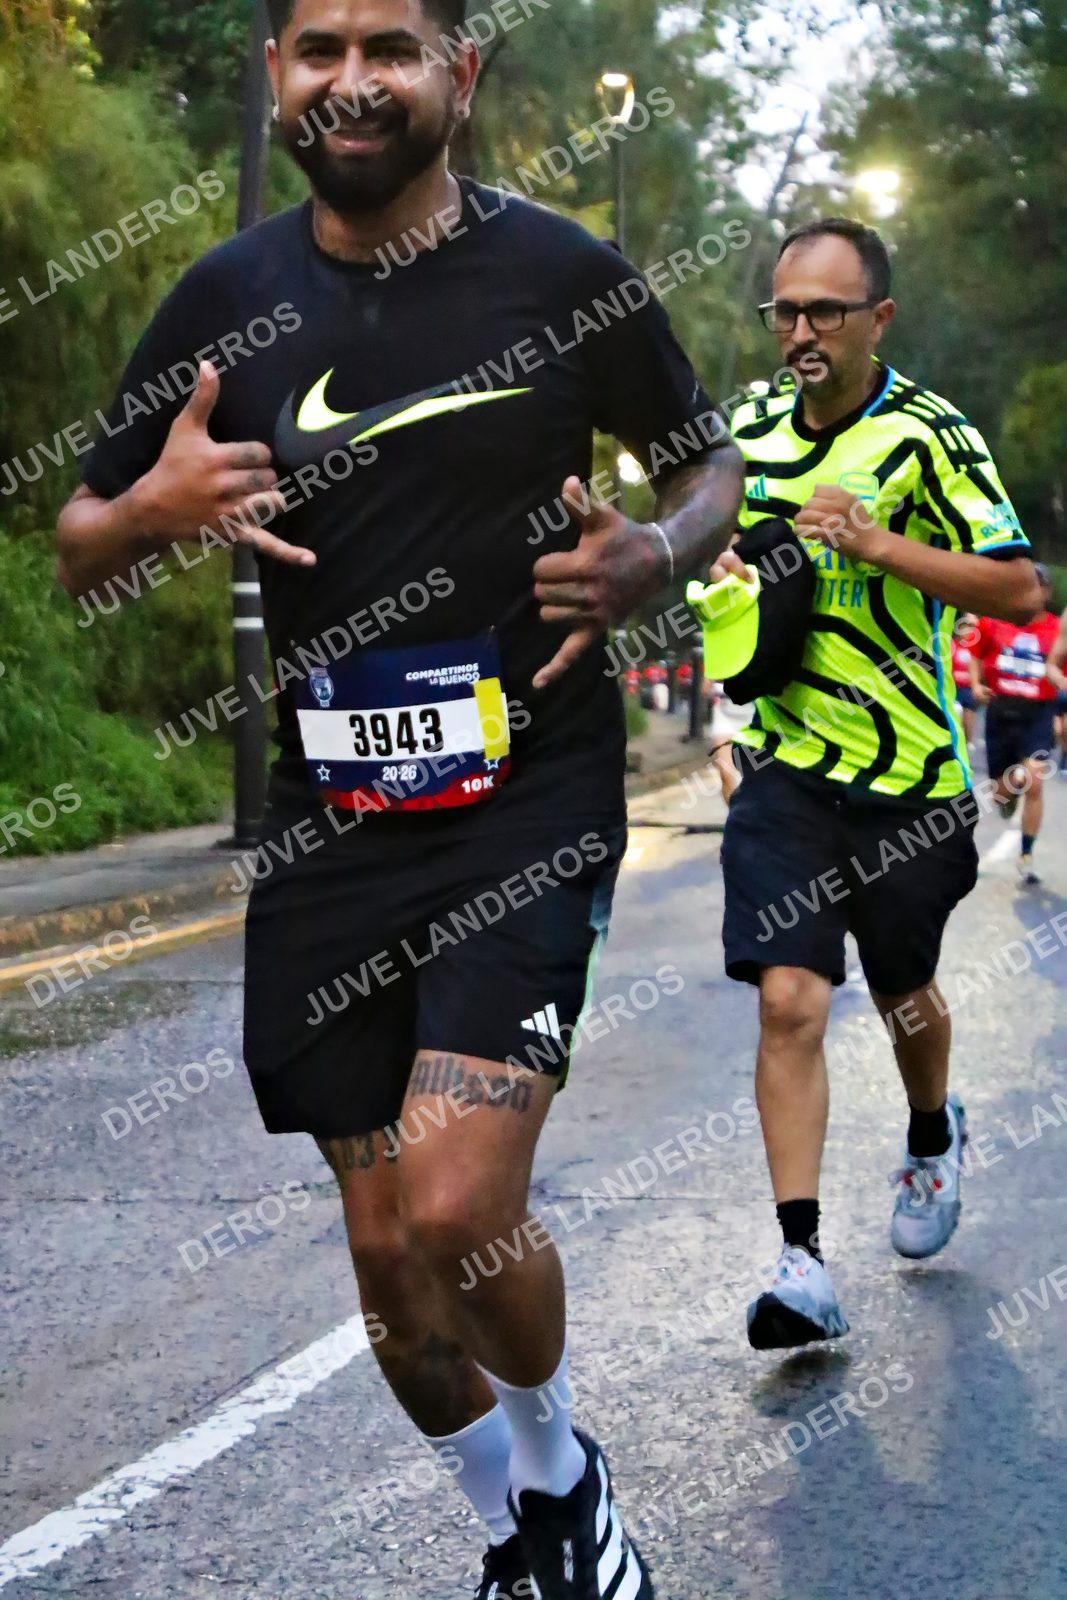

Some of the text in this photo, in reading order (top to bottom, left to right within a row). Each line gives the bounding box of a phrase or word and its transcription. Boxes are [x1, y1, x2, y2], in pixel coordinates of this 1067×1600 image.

[405, 662, 479, 681] COMPARTIMOS
[349, 707, 444, 757] 3943
[461, 775, 494, 794] 10K
